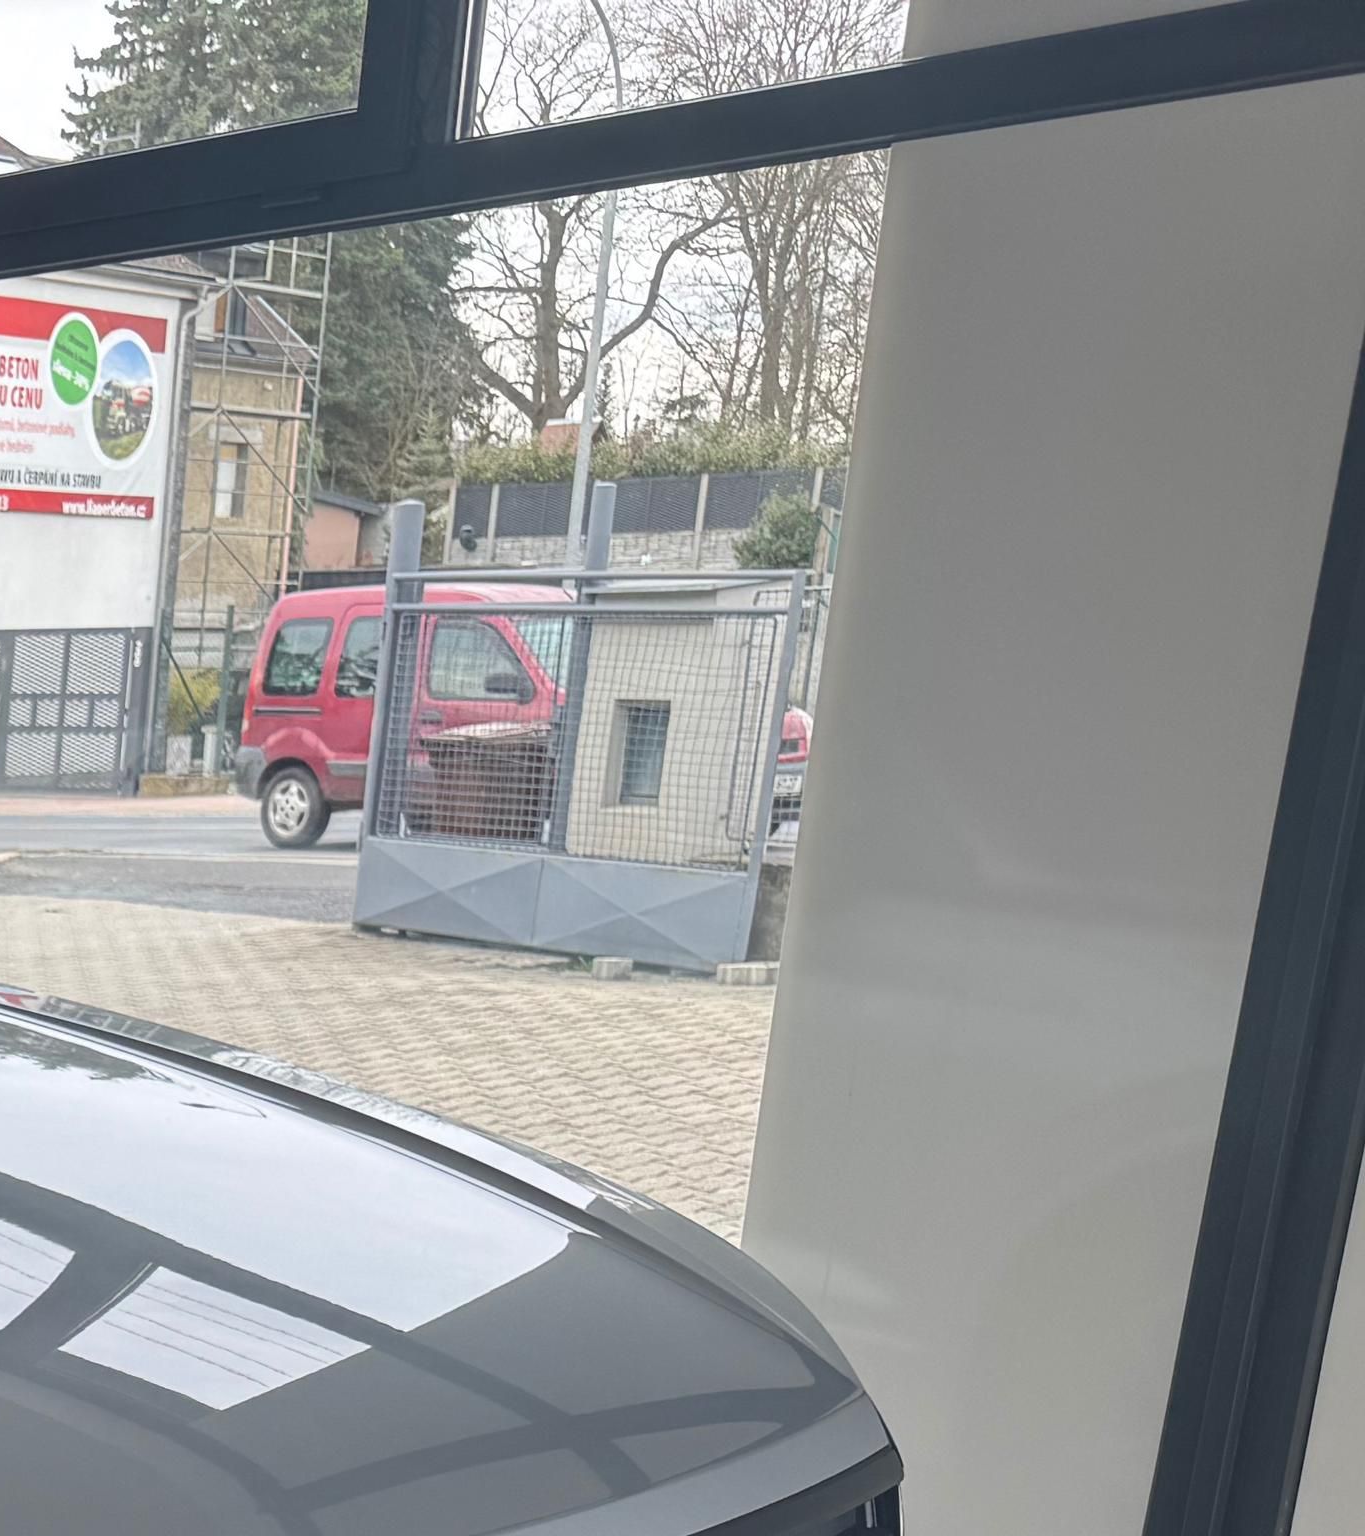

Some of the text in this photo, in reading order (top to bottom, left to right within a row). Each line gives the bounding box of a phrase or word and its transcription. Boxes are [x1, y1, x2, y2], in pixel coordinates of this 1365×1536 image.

[11, 386, 43, 409] CENU
[23, 466, 58, 487] ČERPÁNÍ
[73, 473, 101, 489] STAVBU
